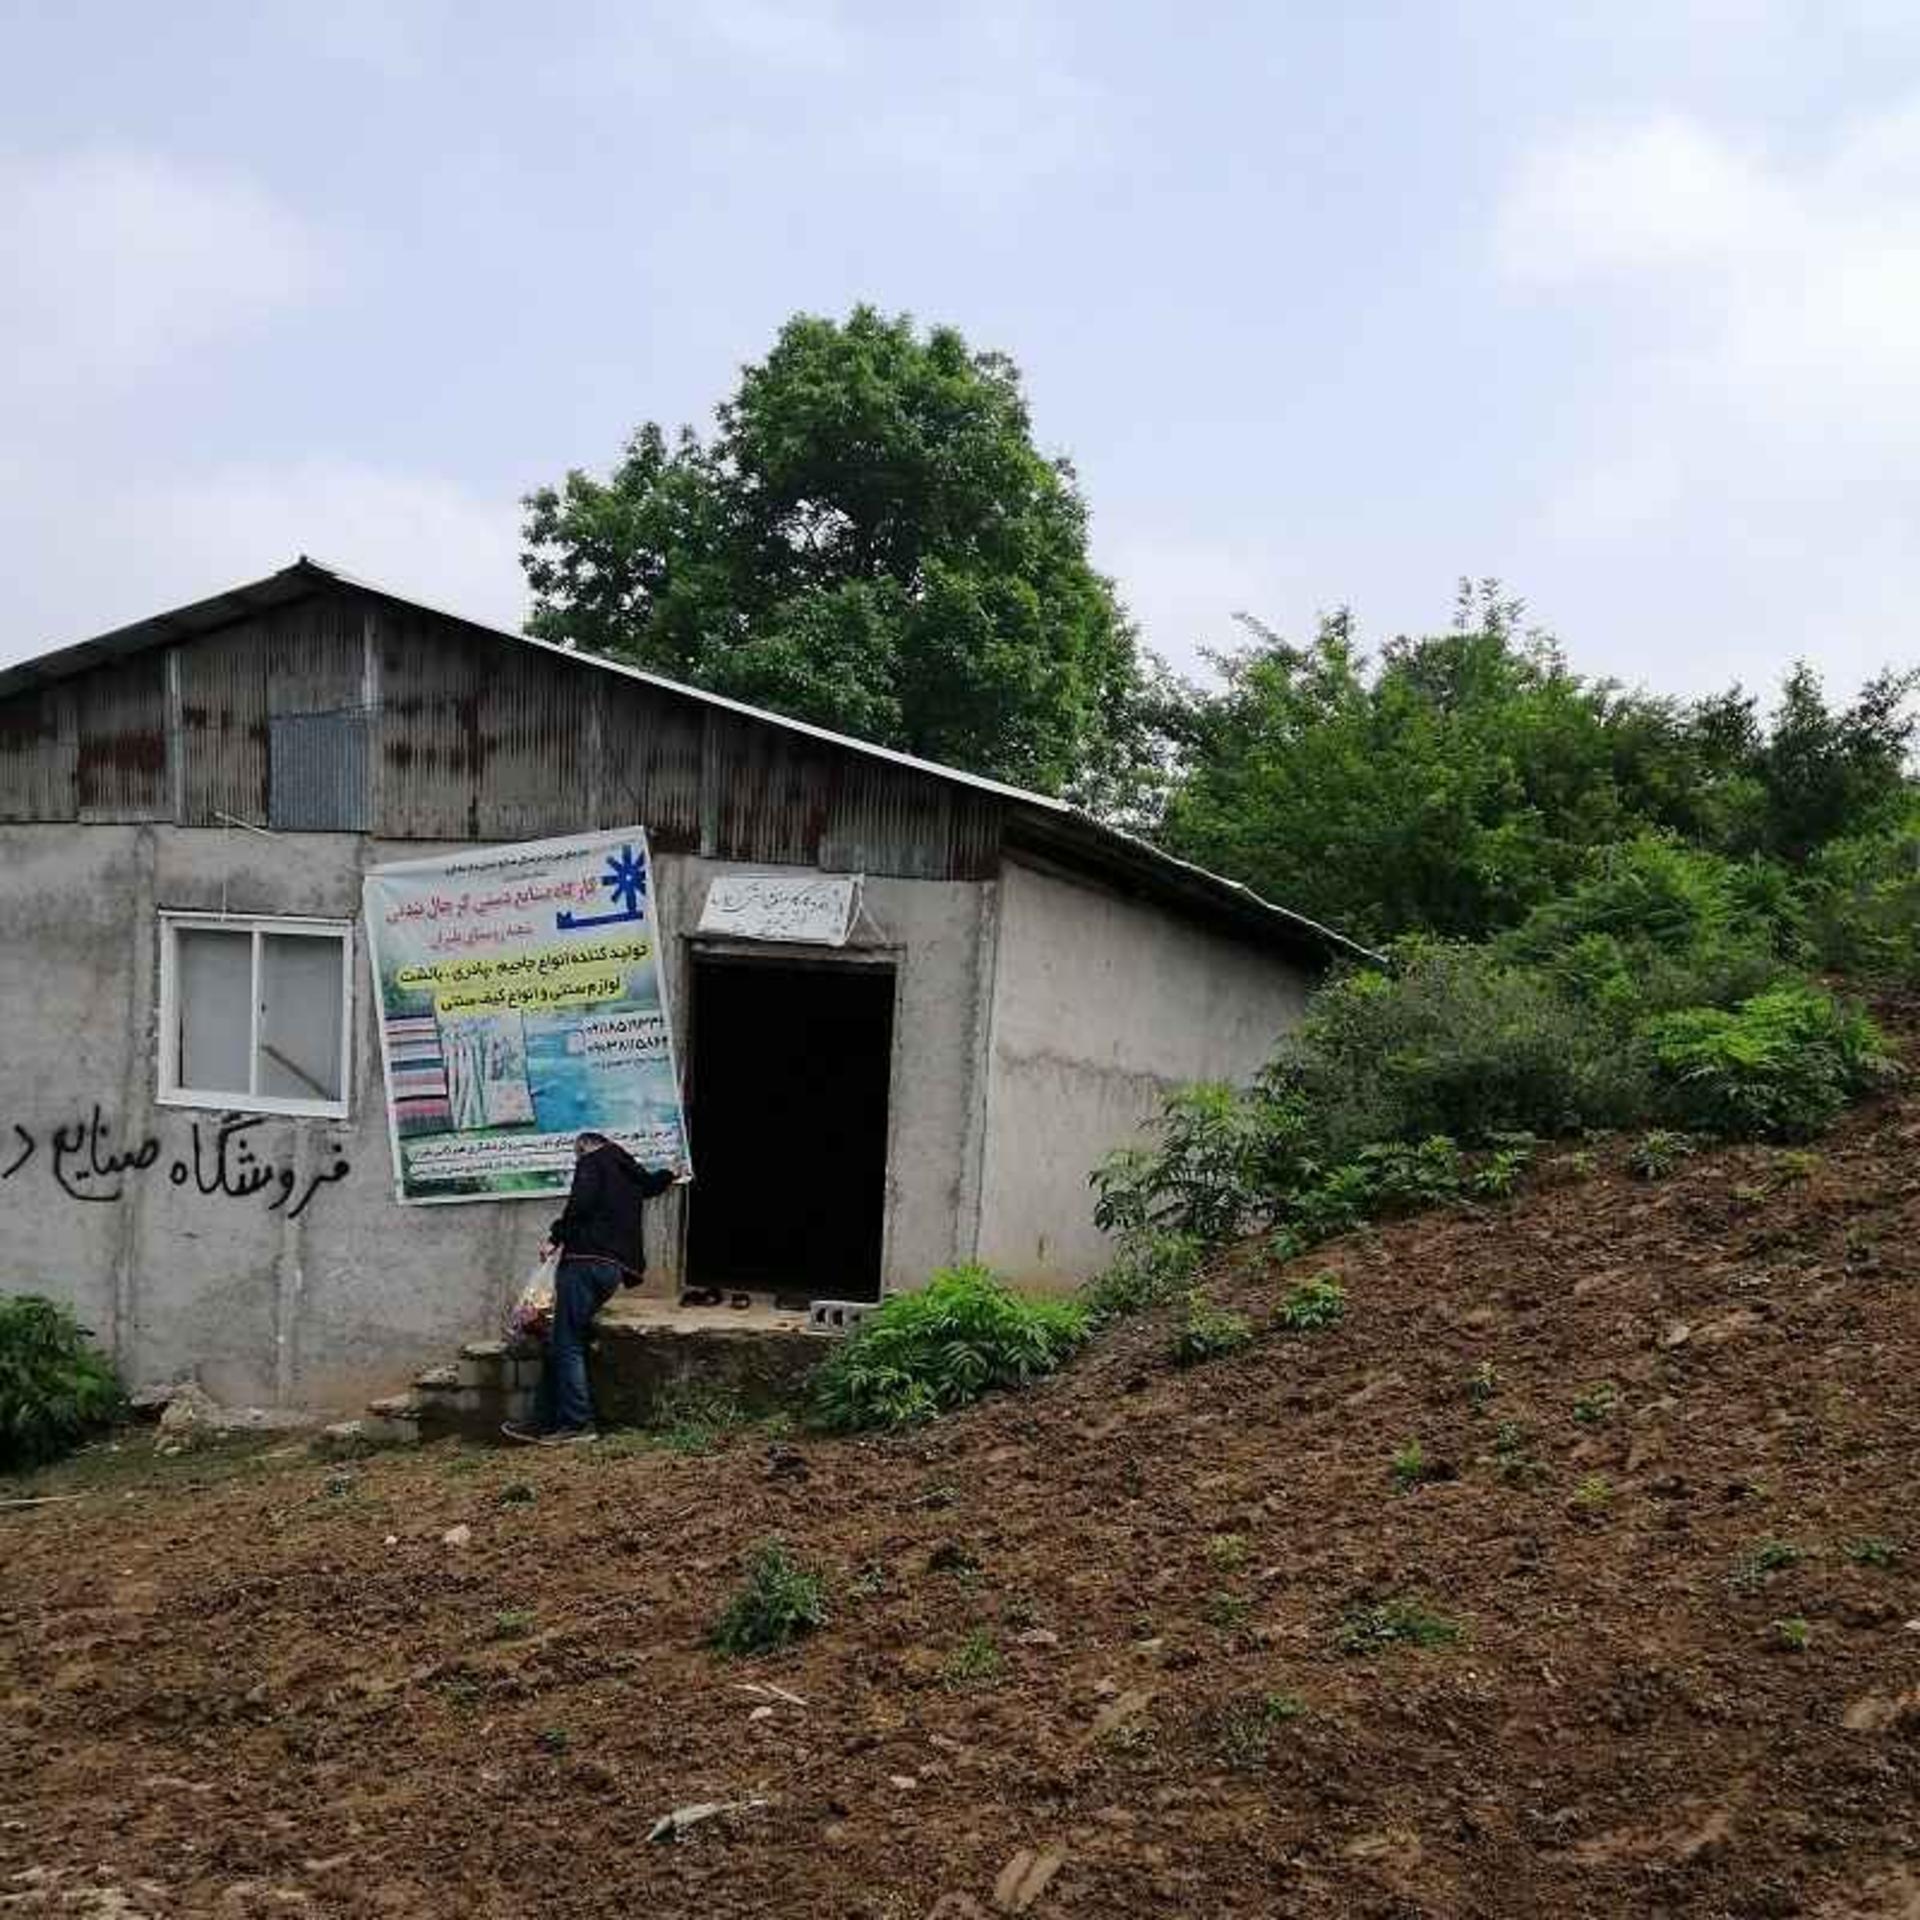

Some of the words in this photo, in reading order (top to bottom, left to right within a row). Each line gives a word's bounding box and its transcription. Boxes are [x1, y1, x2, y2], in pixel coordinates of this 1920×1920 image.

[609, 944, 648, 962] تولید
[53, 1103, 160, 1202] صنایع
[169, 1112, 351, 1219] فروشگاه
